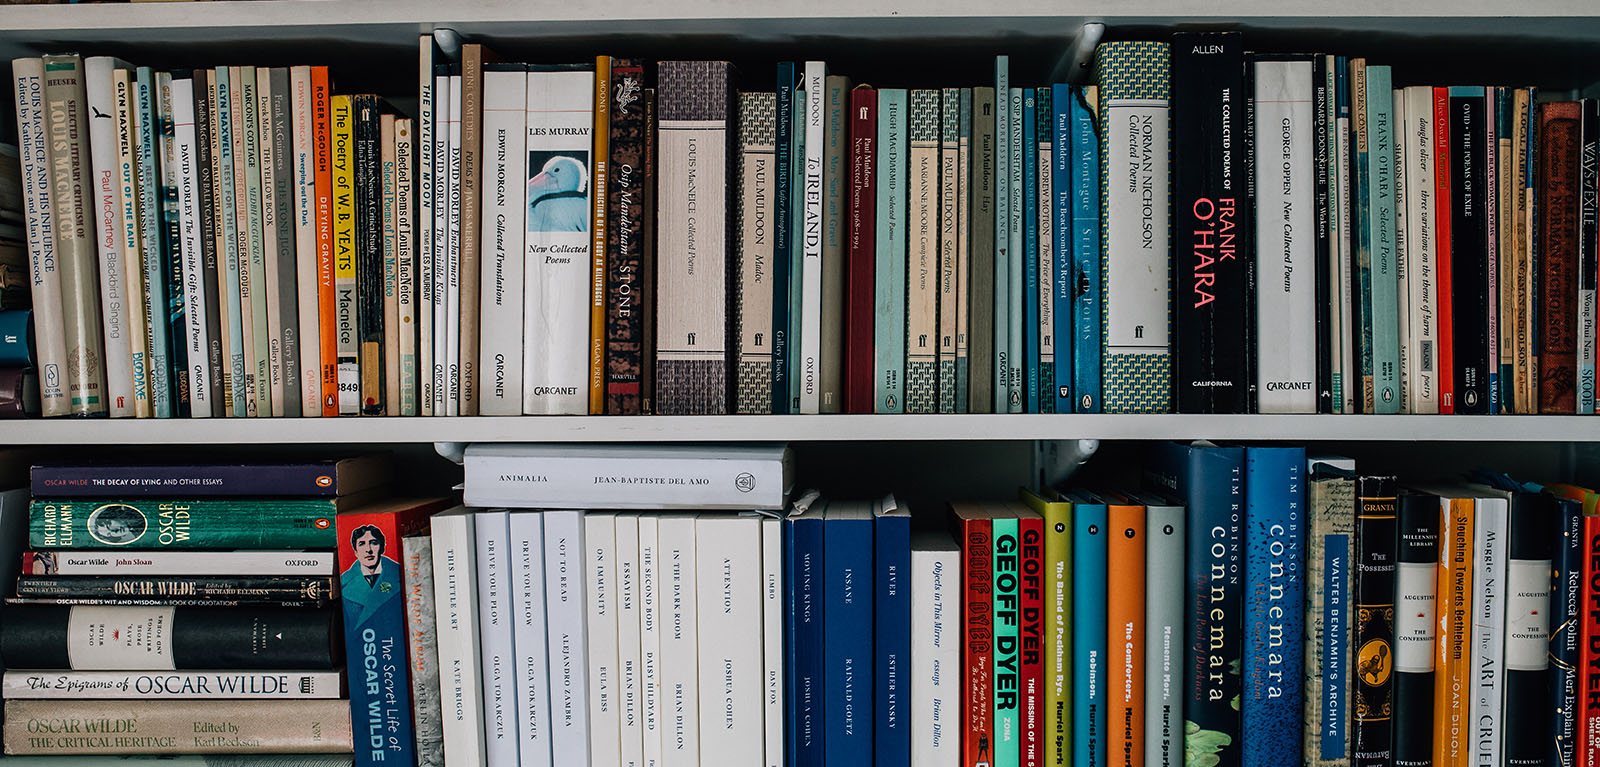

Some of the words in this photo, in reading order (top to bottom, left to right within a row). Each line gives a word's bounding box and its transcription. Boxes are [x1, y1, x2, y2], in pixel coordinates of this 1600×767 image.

[29, 76, 43, 107] LOUIS
[316, 86, 324, 120] ROGER
[811, 76, 820, 126] MULDOON
[336, 106, 348, 127] The
[334, 133, 350, 171] Poetry
[422, 111, 430, 166] DAYLIGHT
[1059, 132, 1067, 169] Maddern
[1129, 115, 1139, 158] Collected
[1142, 115, 1152, 172] NORMAN
[1282, 118, 1290, 159] GEORGE
[181, 144, 190, 174] DAVID
[756, 159, 765, 186] PAUL
[807, 157, 819, 169] To
[854, 155, 862, 182] Selected
[863, 156, 872, 187] Muldoon
[37, 166, 48, 190] AND
[101, 170, 112, 193] Paul
[338, 177, 349, 190] of
[618, 164, 632, 188] Osip
[1129, 162, 1139, 192] Poems
[1224, 179, 1231, 190] OF
[1282, 162, 1291, 195] OPPEN
[1464, 181, 1471, 191] OF
[39, 192, 49, 210] HIS
[182, 177, 192, 217] MORLEY
[338, 194, 350, 212] W.
[805, 174, 820, 249] IRELAND,
[853, 184, 861, 208] Poems
[1059, 191, 1068, 206] The
[1142, 176, 1153, 249] NICHOLSON
[1282, 201, 1292, 220] New
[103, 195, 116, 249] McCartney
[185, 220, 194, 234] The
[320, 197, 328, 239] DEFYING
[339, 214, 350, 224] B.
[619, 190, 632, 254] Mandelstam
[755, 189, 765, 244] MULDOON
[1219, 198, 1235, 261] FRANK
[40, 212, 54, 272] INFLUENCE
[186, 237, 196, 270] Invisible
[338, 228, 351, 270] YEATS
[529, 245, 545, 253] New
[548, 245, 588, 254] Collected
[1283, 224, 1293, 263] Collected
[107, 253, 118, 299] Blackbird
[321, 242, 330, 286] GRAVITY
[545, 256, 571, 264] Poems
[755, 255, 764, 283] Madoc
[187, 274, 197, 292] Gift:
[618, 266, 630, 318] STONE
[1058, 270, 1068, 298] Report
[1284, 266, 1293, 292] Poems
[108, 302, 121, 338] Singing
[190, 295, 199, 325] Selected
[339, 290, 352, 344] Macneice
[192, 328, 200, 352] Poems
[533, 386, 578, 395] CARCANET
[1266, 382, 1311, 391] CARCANET
[594, 476, 666, 485] JEAN-BAPTISTE
[45, 505, 56, 546] RICHARD
[61, 505, 72, 545] ELLMANN
[159, 503, 172, 544] OSCAR
[176, 505, 189, 542] WILDE
[1455, 517, 1467, 562] Slouching
[1289, 503, 1297, 583] ROBINSON
[932, 561, 942, 590] Objects
[997, 535, 1016, 627] GEOFF
[1331, 557, 1339, 605] WALTER
[1454, 566, 1466, 606] Towards
[1568, 571, 1579, 615] Rebecca
[934, 603, 942, 619] This
[1268, 524, 1284, 699] connemara
[381, 637, 393, 660] The
[933, 622, 942, 647] Mirror
[1453, 610, 1464, 659] Bethlehem
[1567, 619, 1577, 650] Solnit
[362, 628, 380, 695] OSCAR
[725, 659, 733, 694] JOSHUA
[932, 660, 940, 686] essays
[997, 636, 1016, 709] DYER
[27, 677, 50, 690] The
[55, 678, 112, 691] Epigrams
[116, 677, 128, 689] of
[136, 676, 211, 694] OSCAR
[216, 676, 288, 693] WILDE
[383, 665, 397, 704] Secret
[386, 709, 398, 732] Life
[455, 688, 463, 721] BRIGGS
[368, 700, 384, 761] WILDE
[389, 737, 401, 752] of
[932, 723, 941, 747] Dillon
